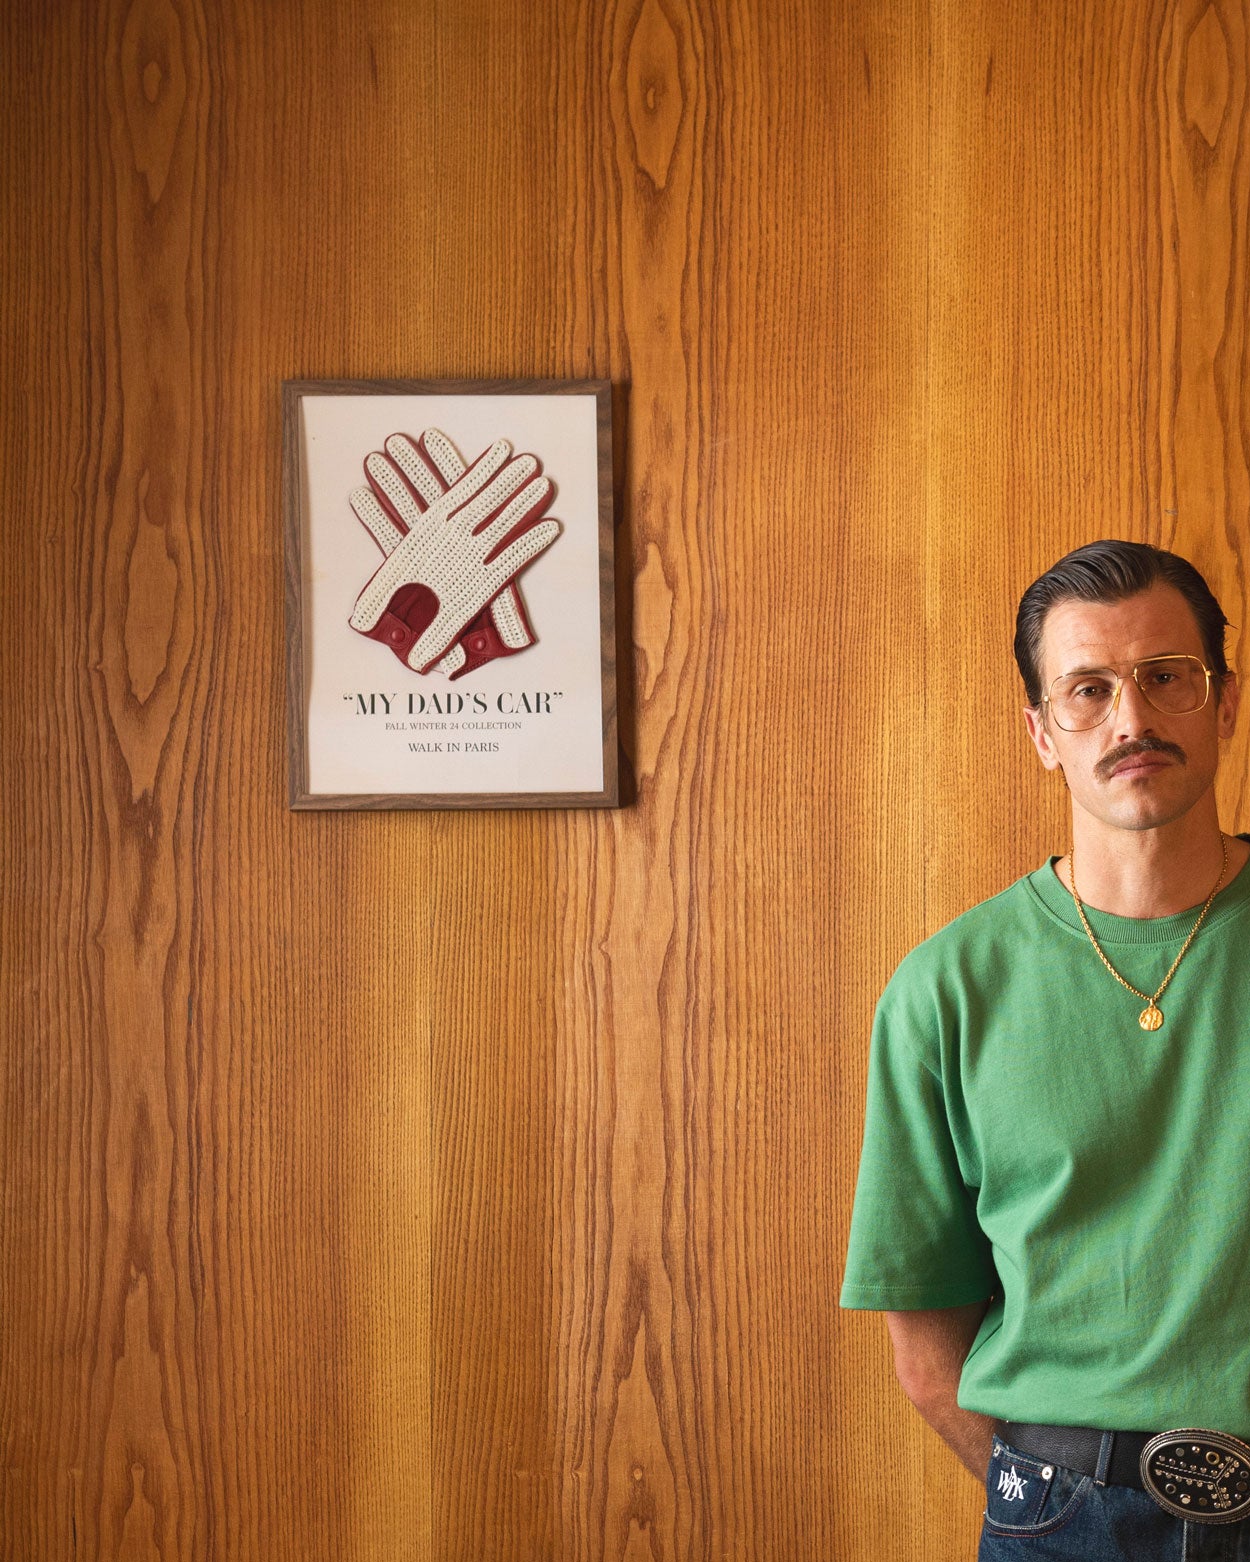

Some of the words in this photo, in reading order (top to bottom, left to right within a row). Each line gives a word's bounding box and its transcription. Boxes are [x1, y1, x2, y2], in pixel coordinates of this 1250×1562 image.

[385, 722, 408, 731] FALL
[409, 722, 447, 731] WINTER
[449, 722, 460, 731] 24
[461, 721, 522, 730] COLLECTION
[408, 743, 442, 753] WALK
[447, 743, 461, 753] IN
[464, 742, 500, 753] PARIS
